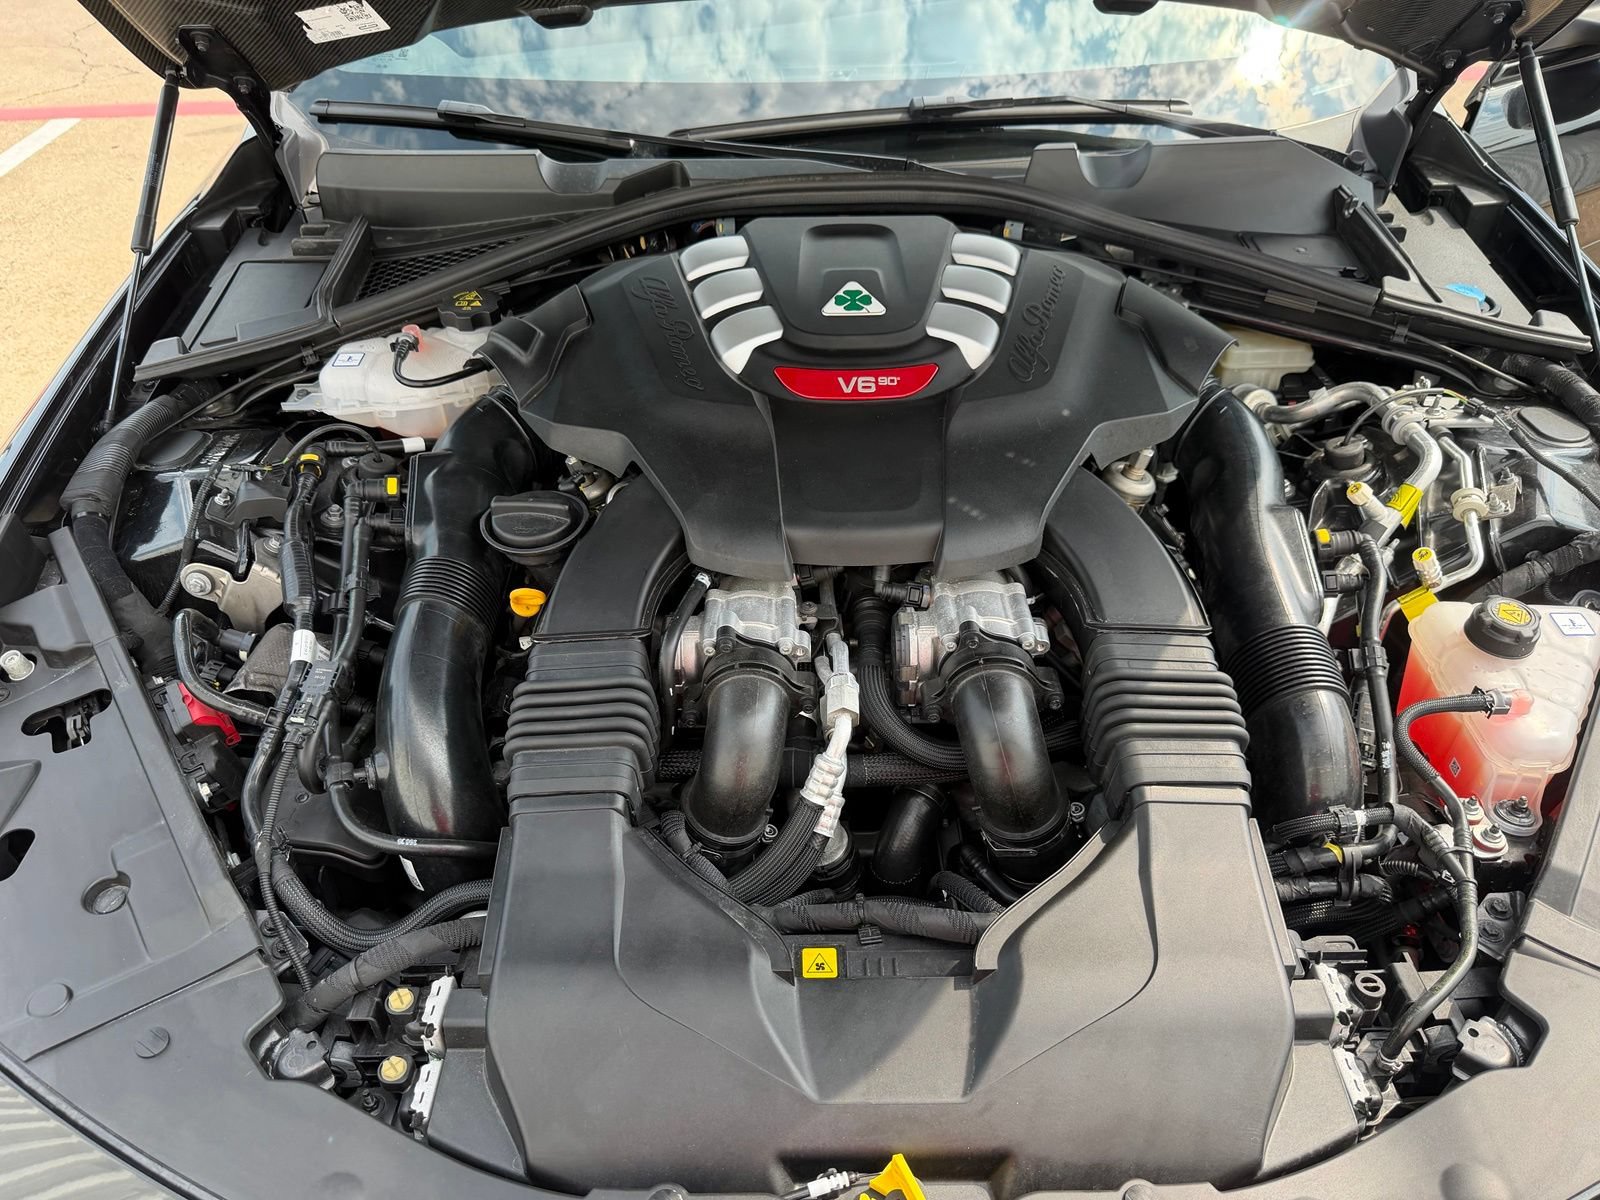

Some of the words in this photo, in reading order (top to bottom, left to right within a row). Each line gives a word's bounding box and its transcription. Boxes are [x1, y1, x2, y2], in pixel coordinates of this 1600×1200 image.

[1022, 264, 1066, 330] Romeo
[631, 277, 679, 324] Alfa
[663, 319, 705, 391] Romeo
[1008, 331, 1050, 383] Alfa
[837, 376, 876, 394] V6
